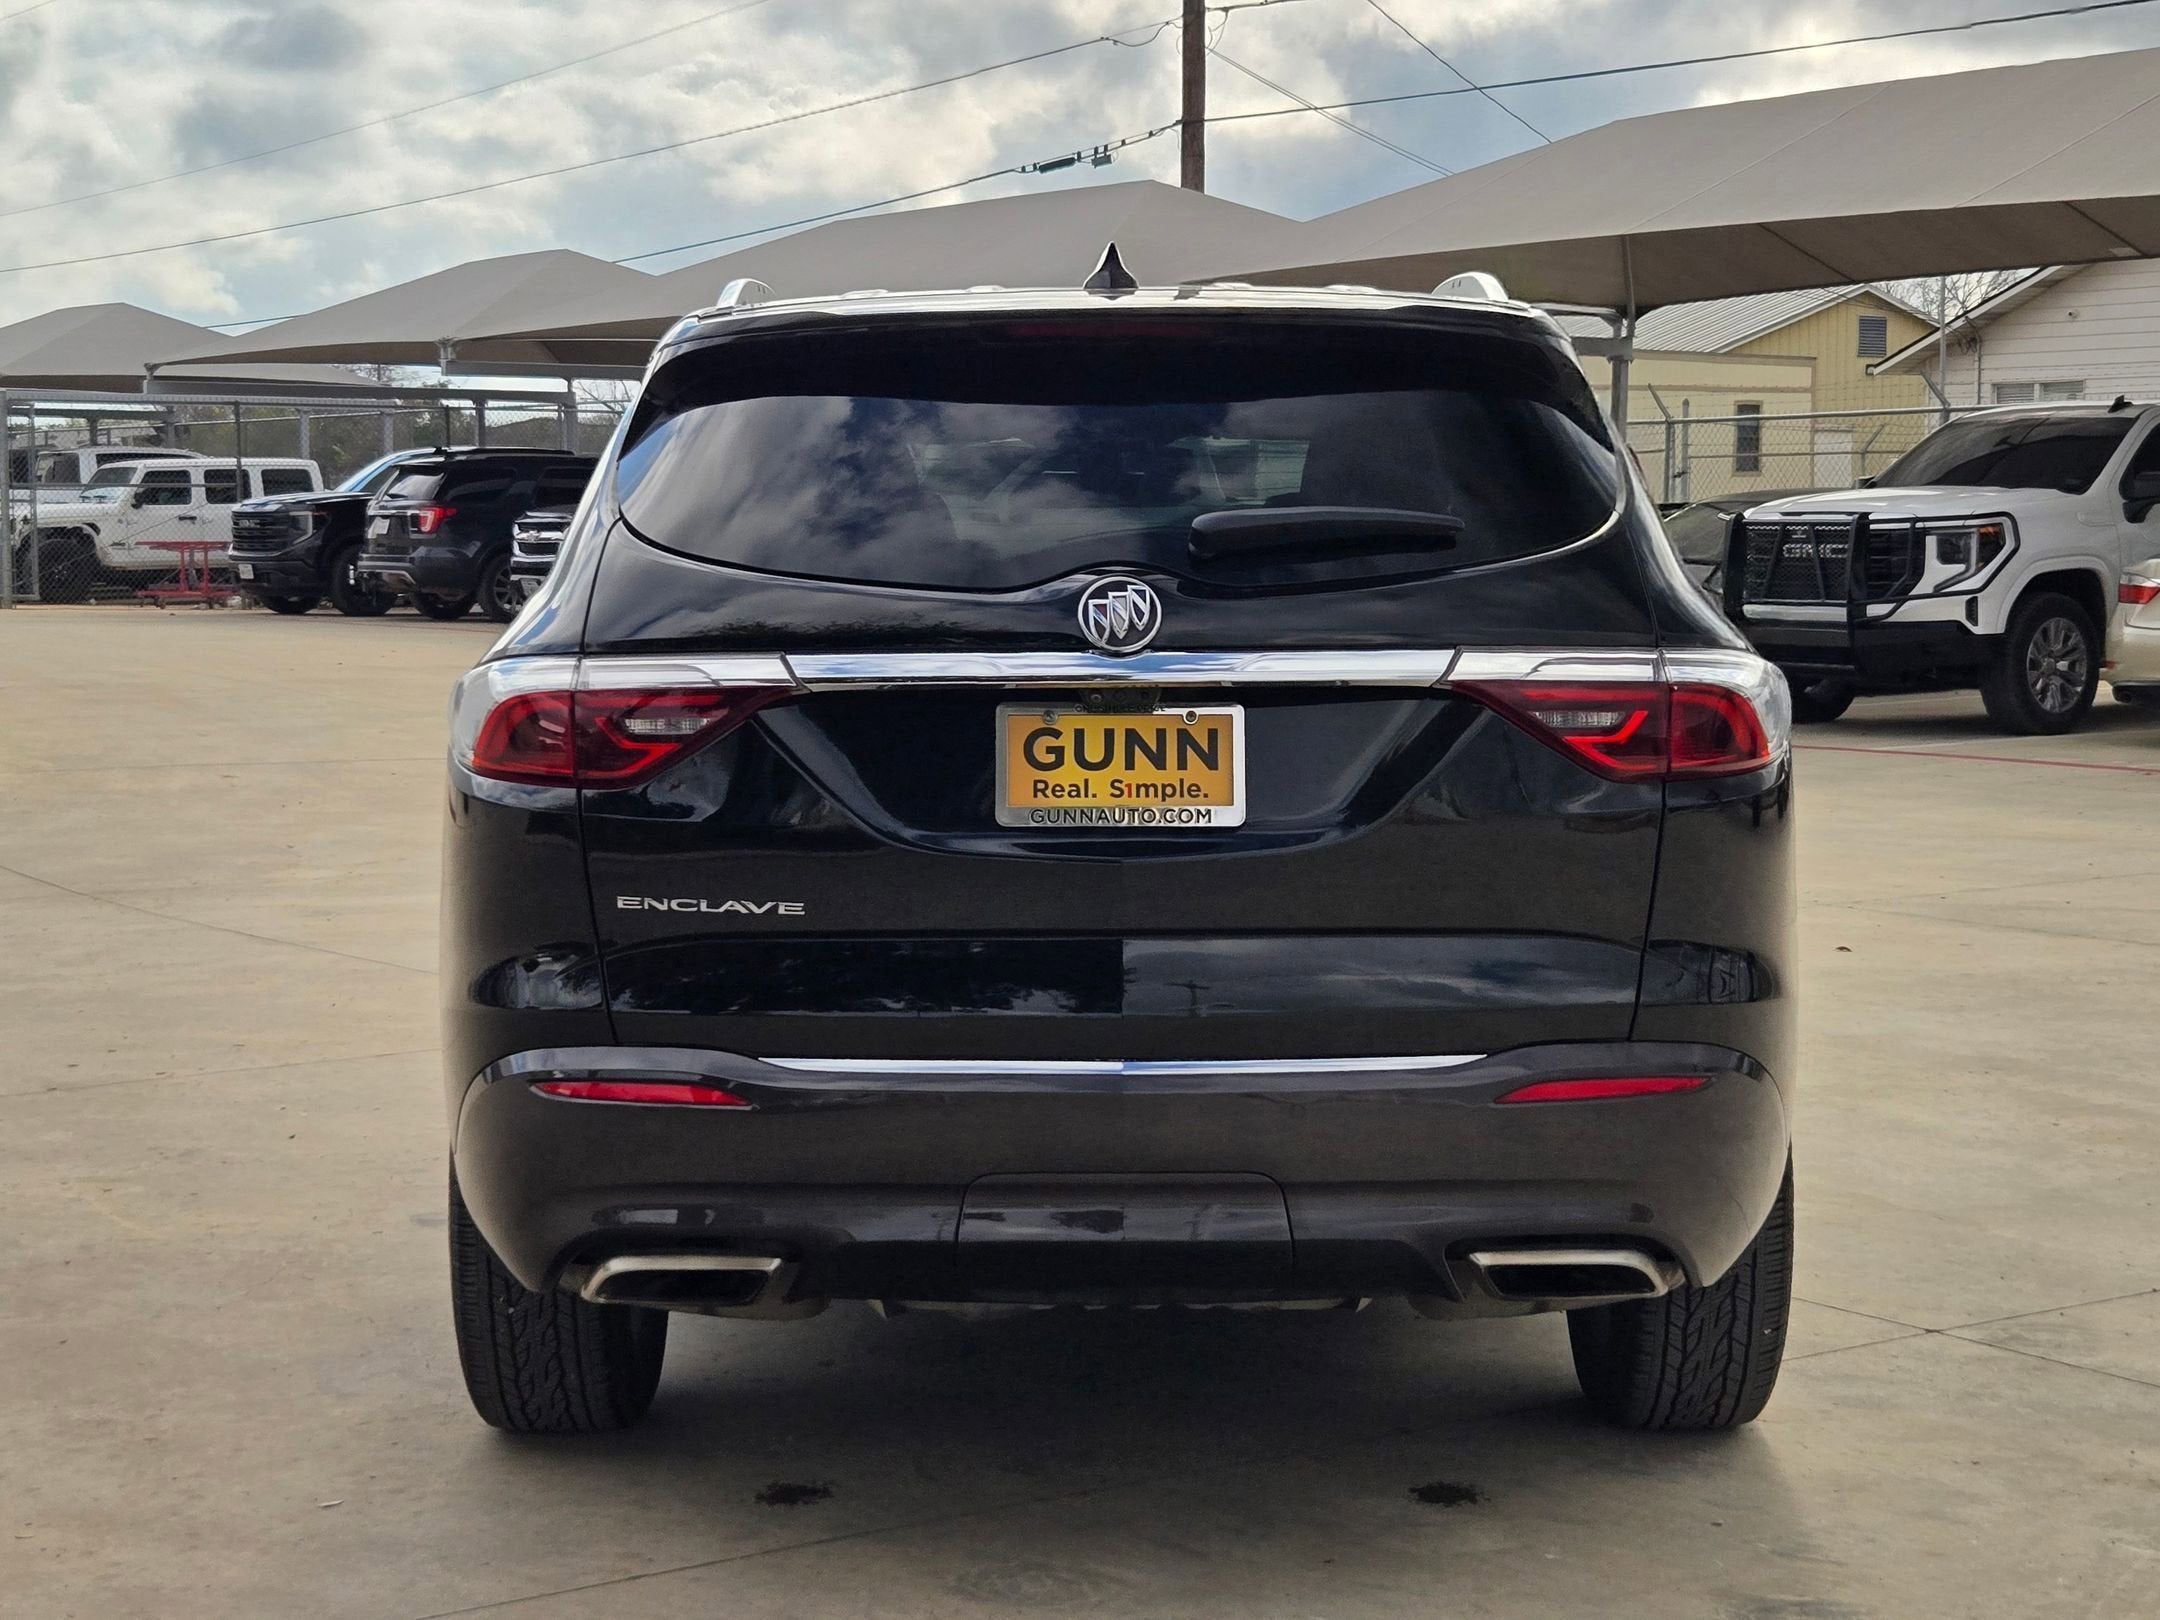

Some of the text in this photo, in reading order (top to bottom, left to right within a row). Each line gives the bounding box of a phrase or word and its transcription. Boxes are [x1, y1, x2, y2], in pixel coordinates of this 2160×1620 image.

[1023, 727, 1219, 772] GUNN
[1033, 779, 1098, 799] Real.
[1030, 808, 1212, 824] GUNNAUTO.COM
[617, 896, 806, 916] ENCLAVE
